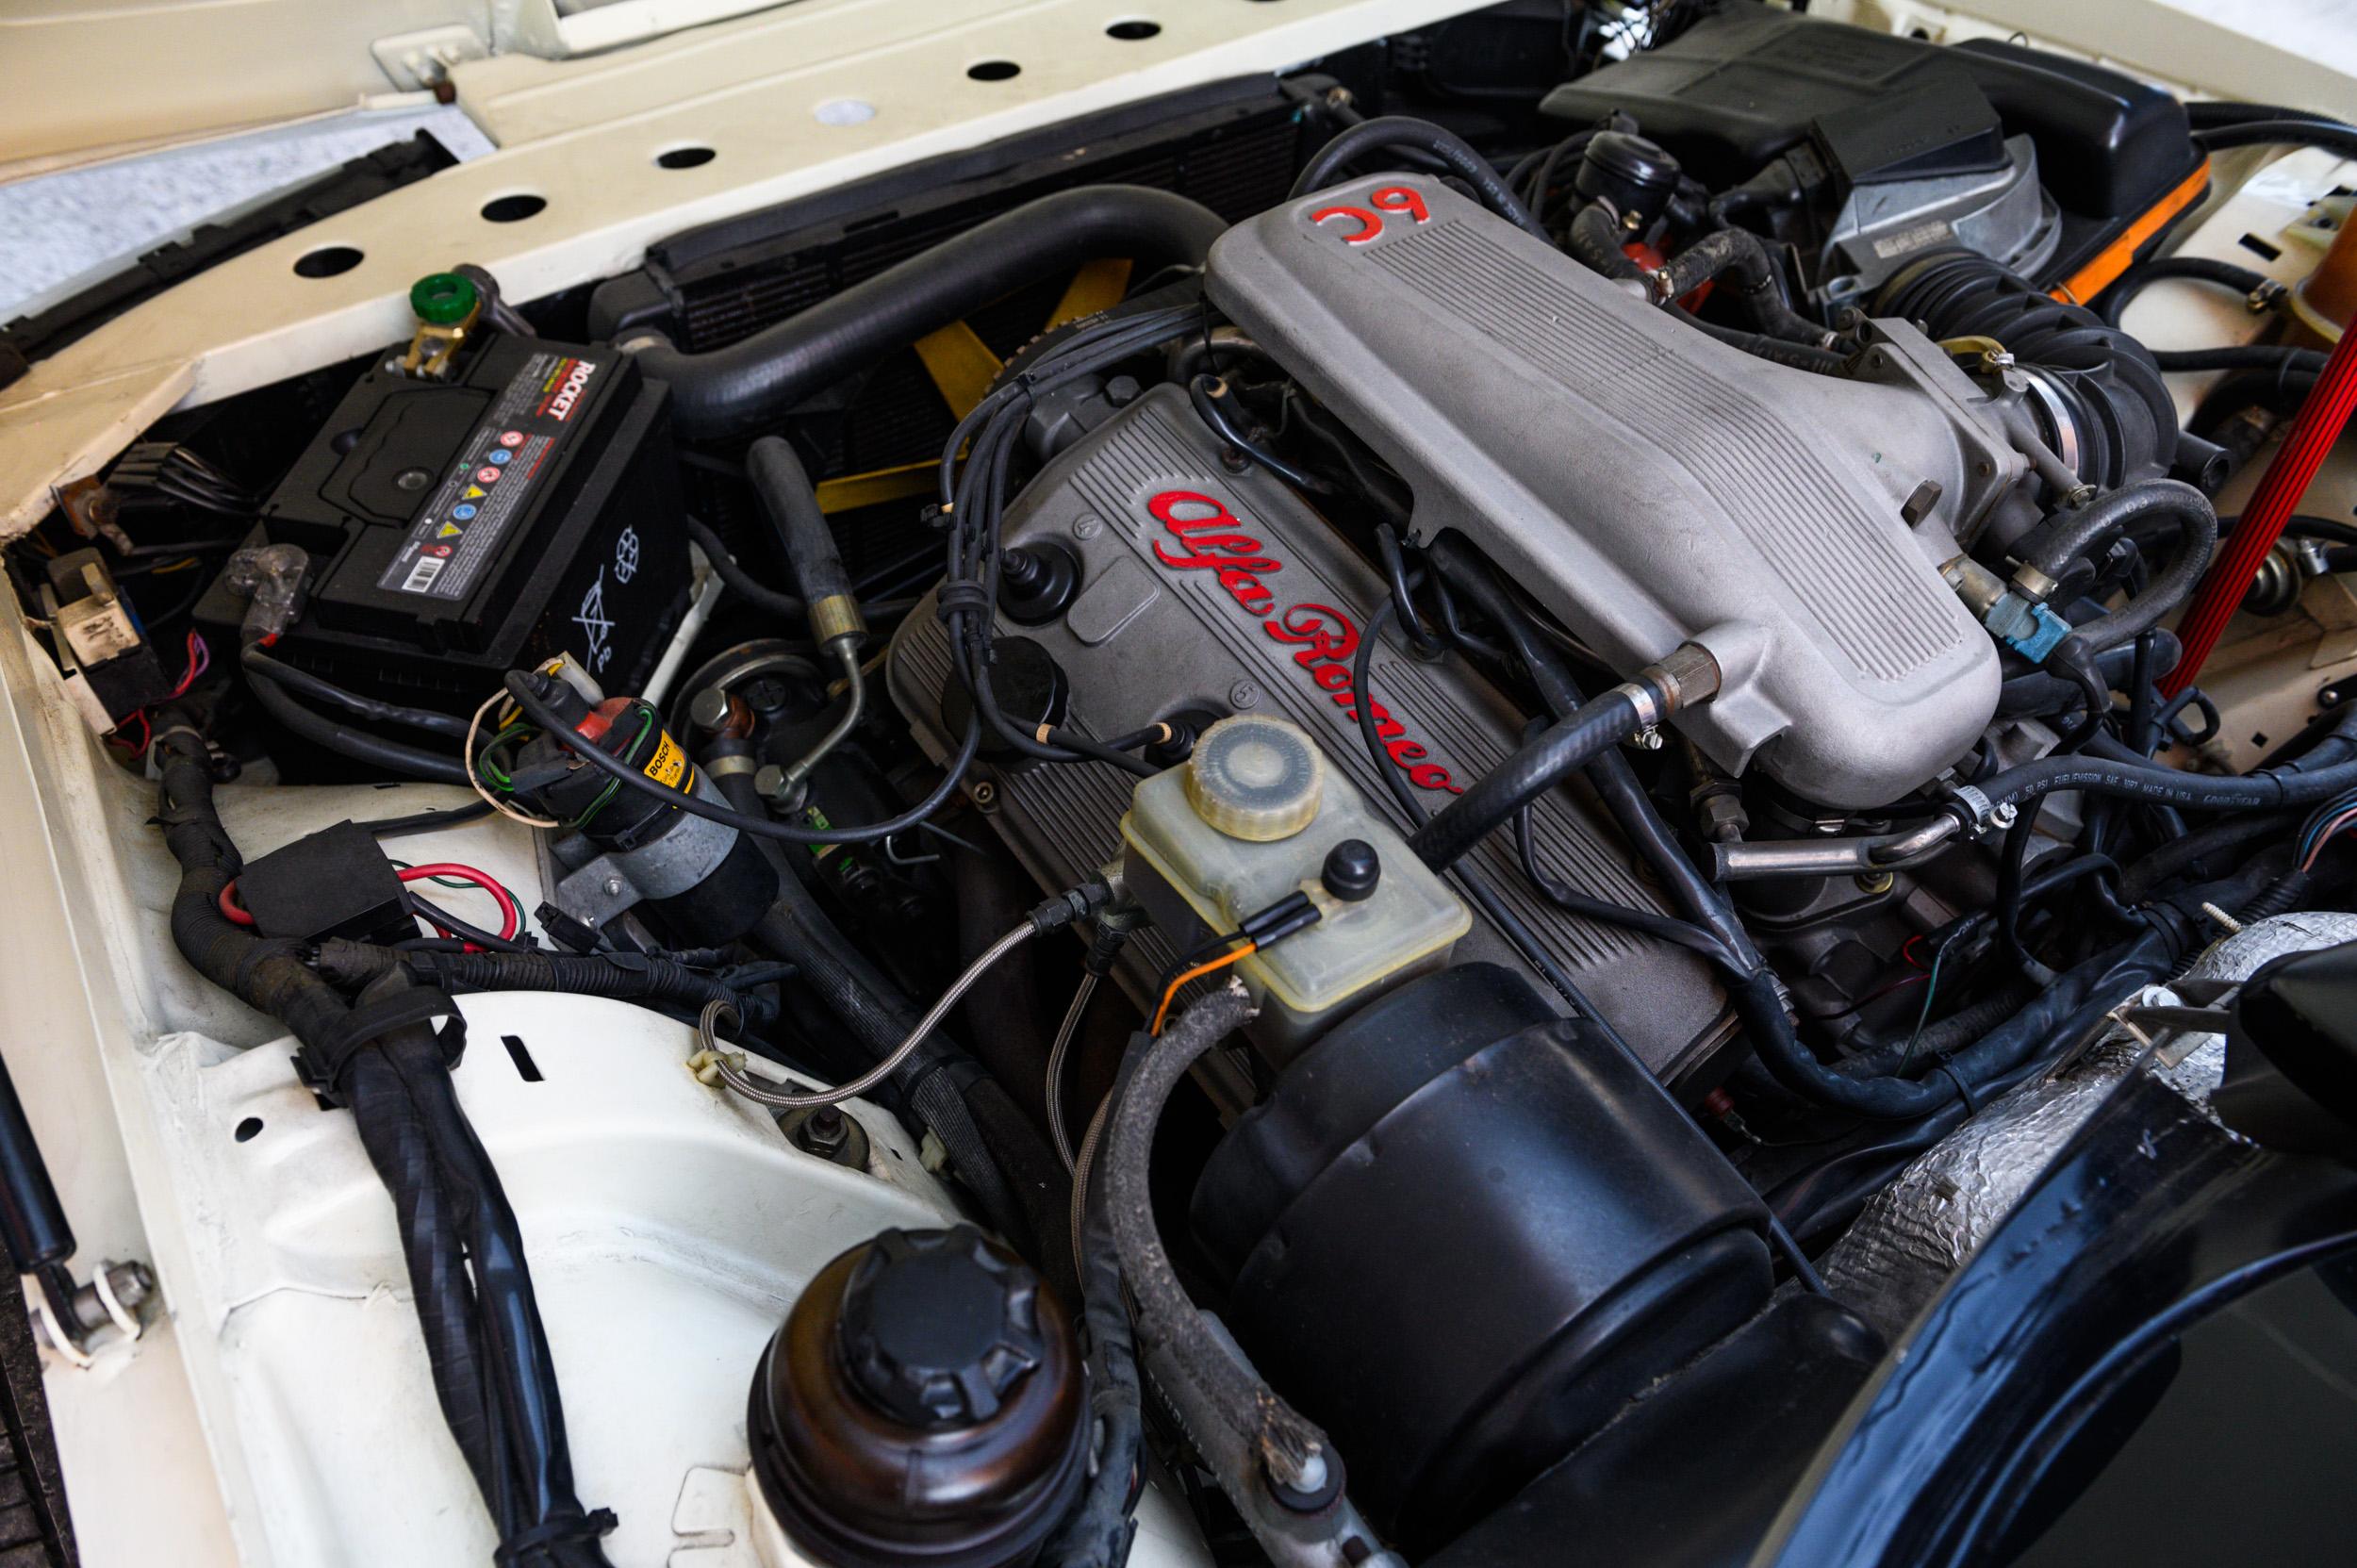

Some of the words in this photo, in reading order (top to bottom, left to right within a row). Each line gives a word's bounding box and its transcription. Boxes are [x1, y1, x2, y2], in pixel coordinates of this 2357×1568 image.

[1310, 186, 1431, 246] 6C
[548, 360, 597, 421] ROCKET
[1147, 489, 1283, 618] Alfa
[1262, 602, 1464, 796] Romeo
[649, 740, 670, 776] BOSCH
[2036, 781, 2049, 791] PSI
[2105, 774, 2118, 786] SAE
[2143, 784, 2165, 797] MADE
[2166, 787, 2174, 798] IN
[2176, 790, 2192, 801] USA
